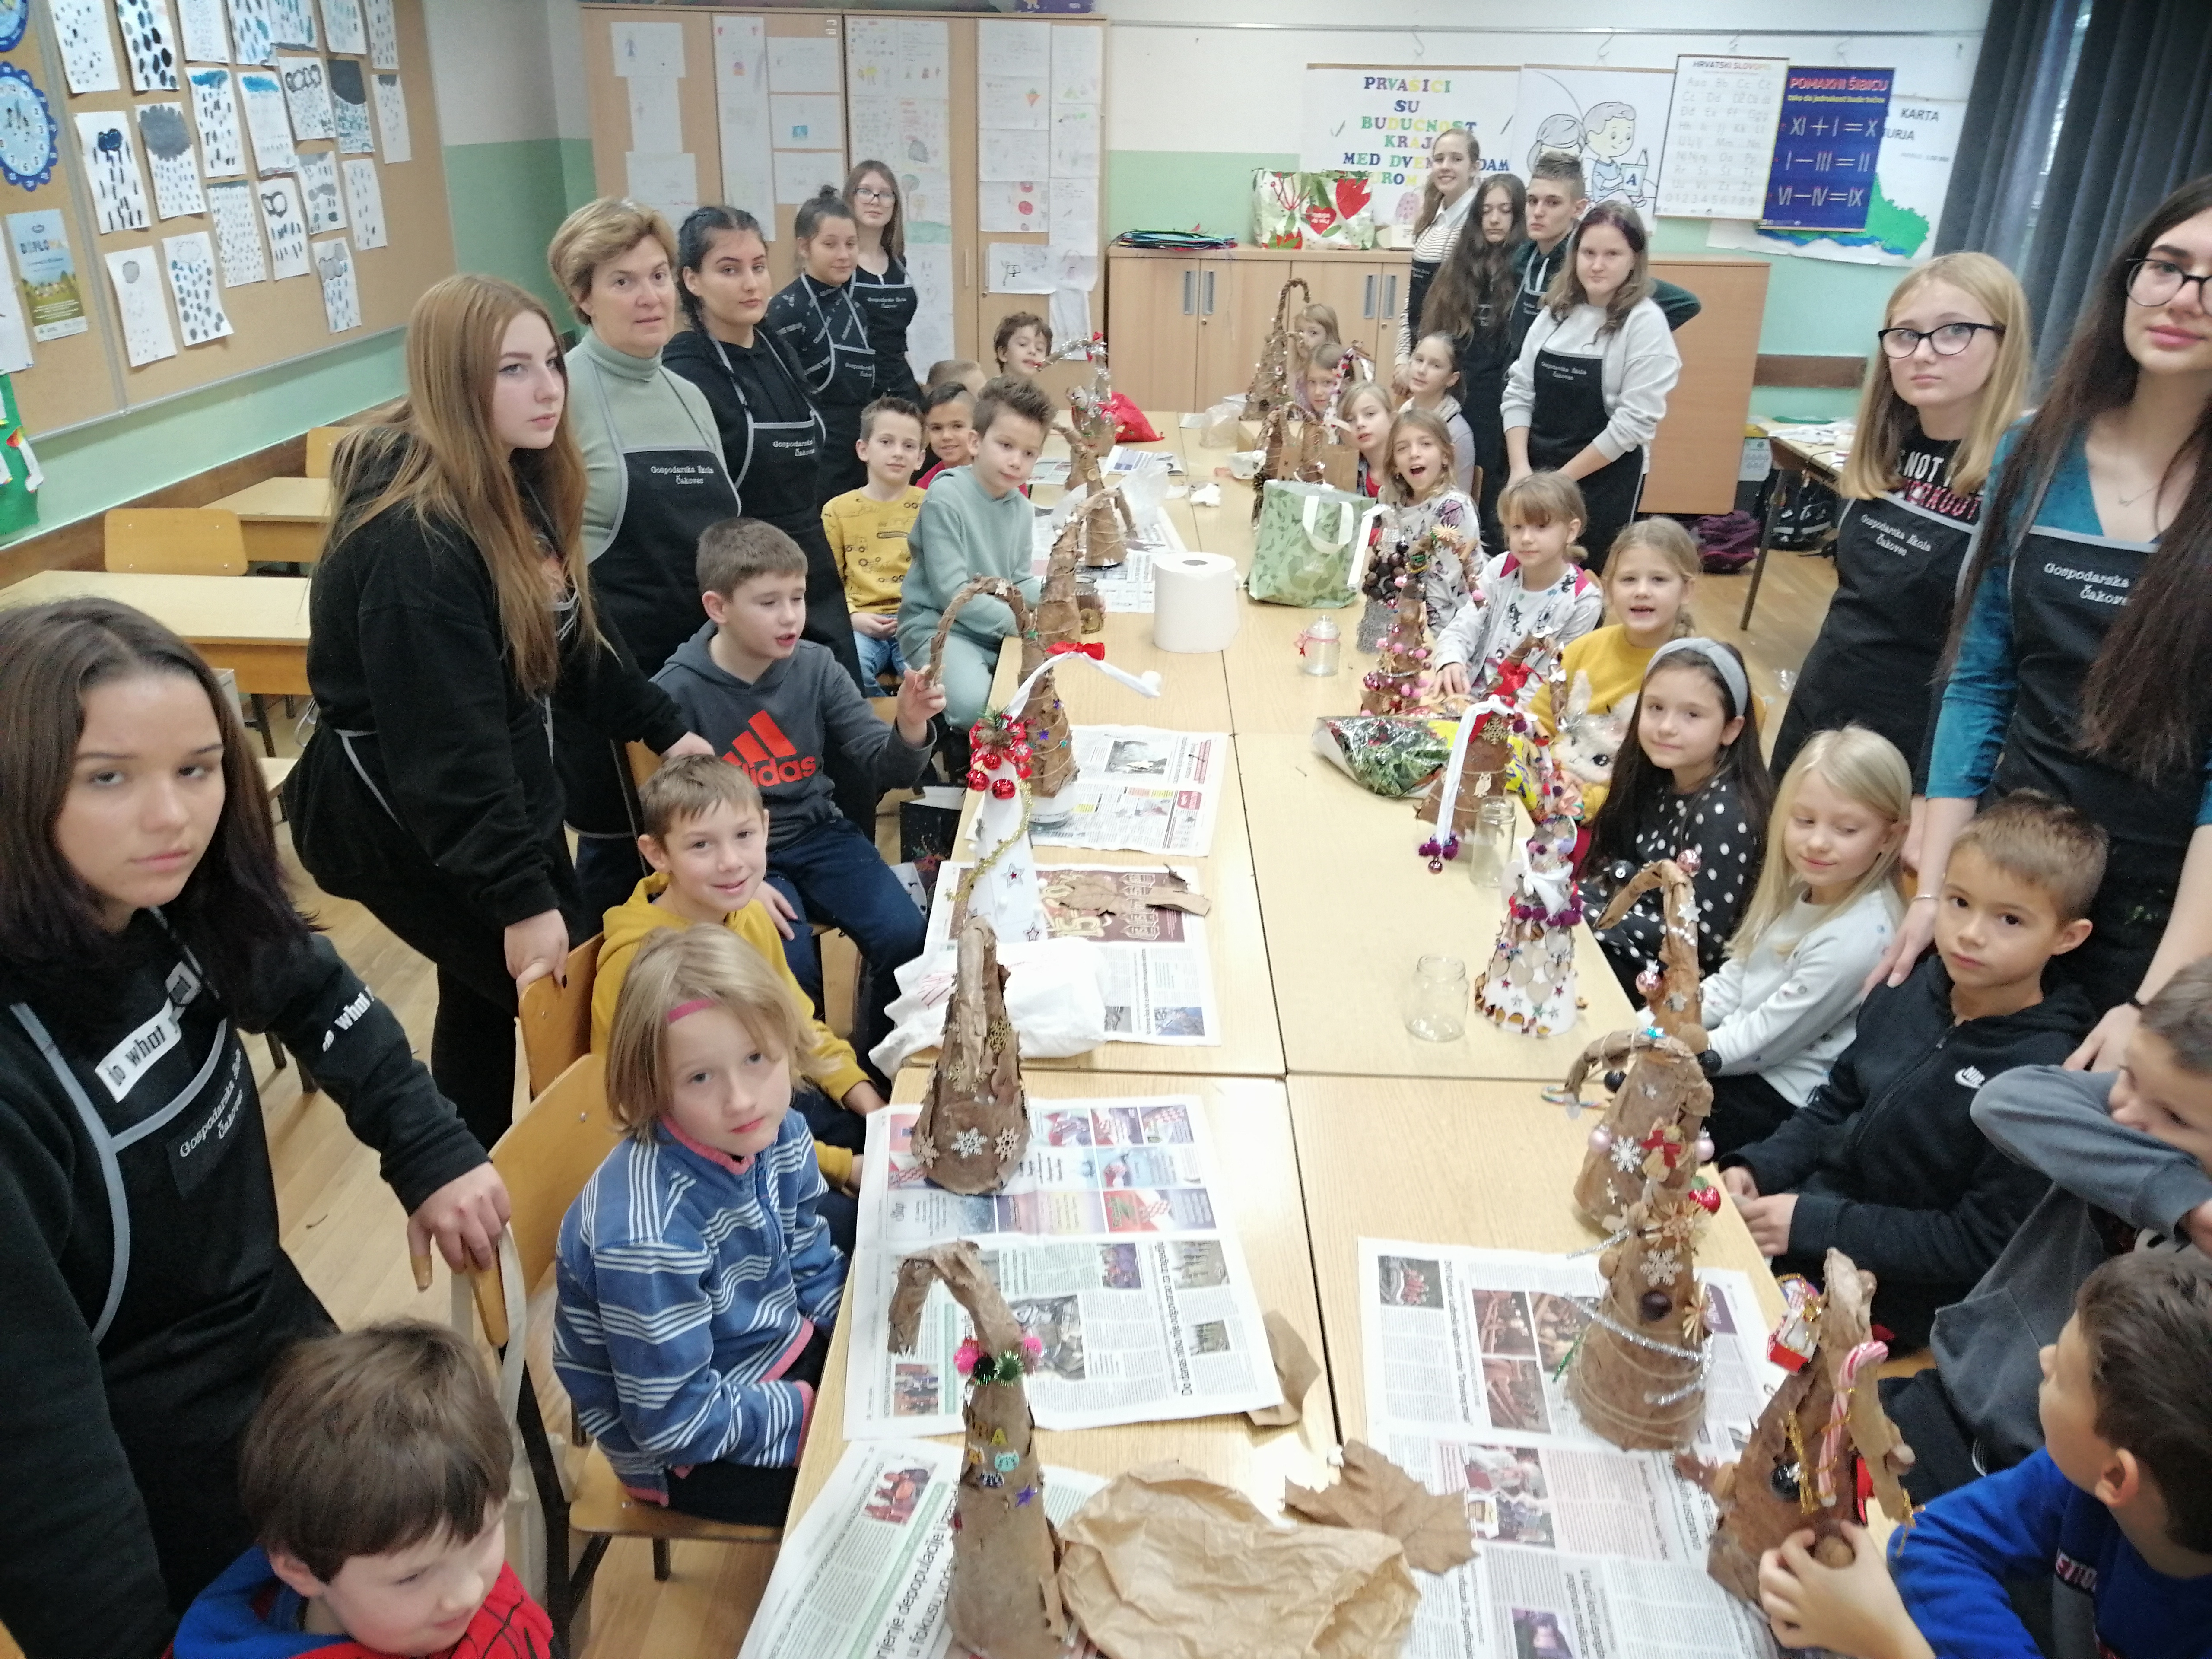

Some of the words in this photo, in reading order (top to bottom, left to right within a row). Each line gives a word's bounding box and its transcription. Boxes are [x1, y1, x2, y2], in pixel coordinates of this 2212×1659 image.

[1789, 77, 1846, 91] POMAKNI
[1847, 77, 1889, 91] ŠIBICU
[1394, 100, 1420, 112] SU
[1901, 108, 1939, 122] KARTA
[1790, 116, 1806, 137] XI
[1865, 118, 1878, 137] X
[1343, 152, 1380, 165] MED
[1815, 151, 1833, 172] III
[1858, 152, 1871, 172] II
[1627, 173, 1637, 185] A
[1778, 185, 1793, 206] VI
[1811, 186, 1829, 207] IV
[1847, 187, 1864, 207] IX
[650, 465, 695, 475] Gospodarska
[1903, 451, 1944, 483] NOT
[675, 474, 704, 485] Čakovec
[2044, 562, 2130, 588] Gospodarska
[124, 1024, 165, 1068] what
[896, 1532, 943, 1621] depopulacije
[915, 1599, 941, 1648] fokusu
